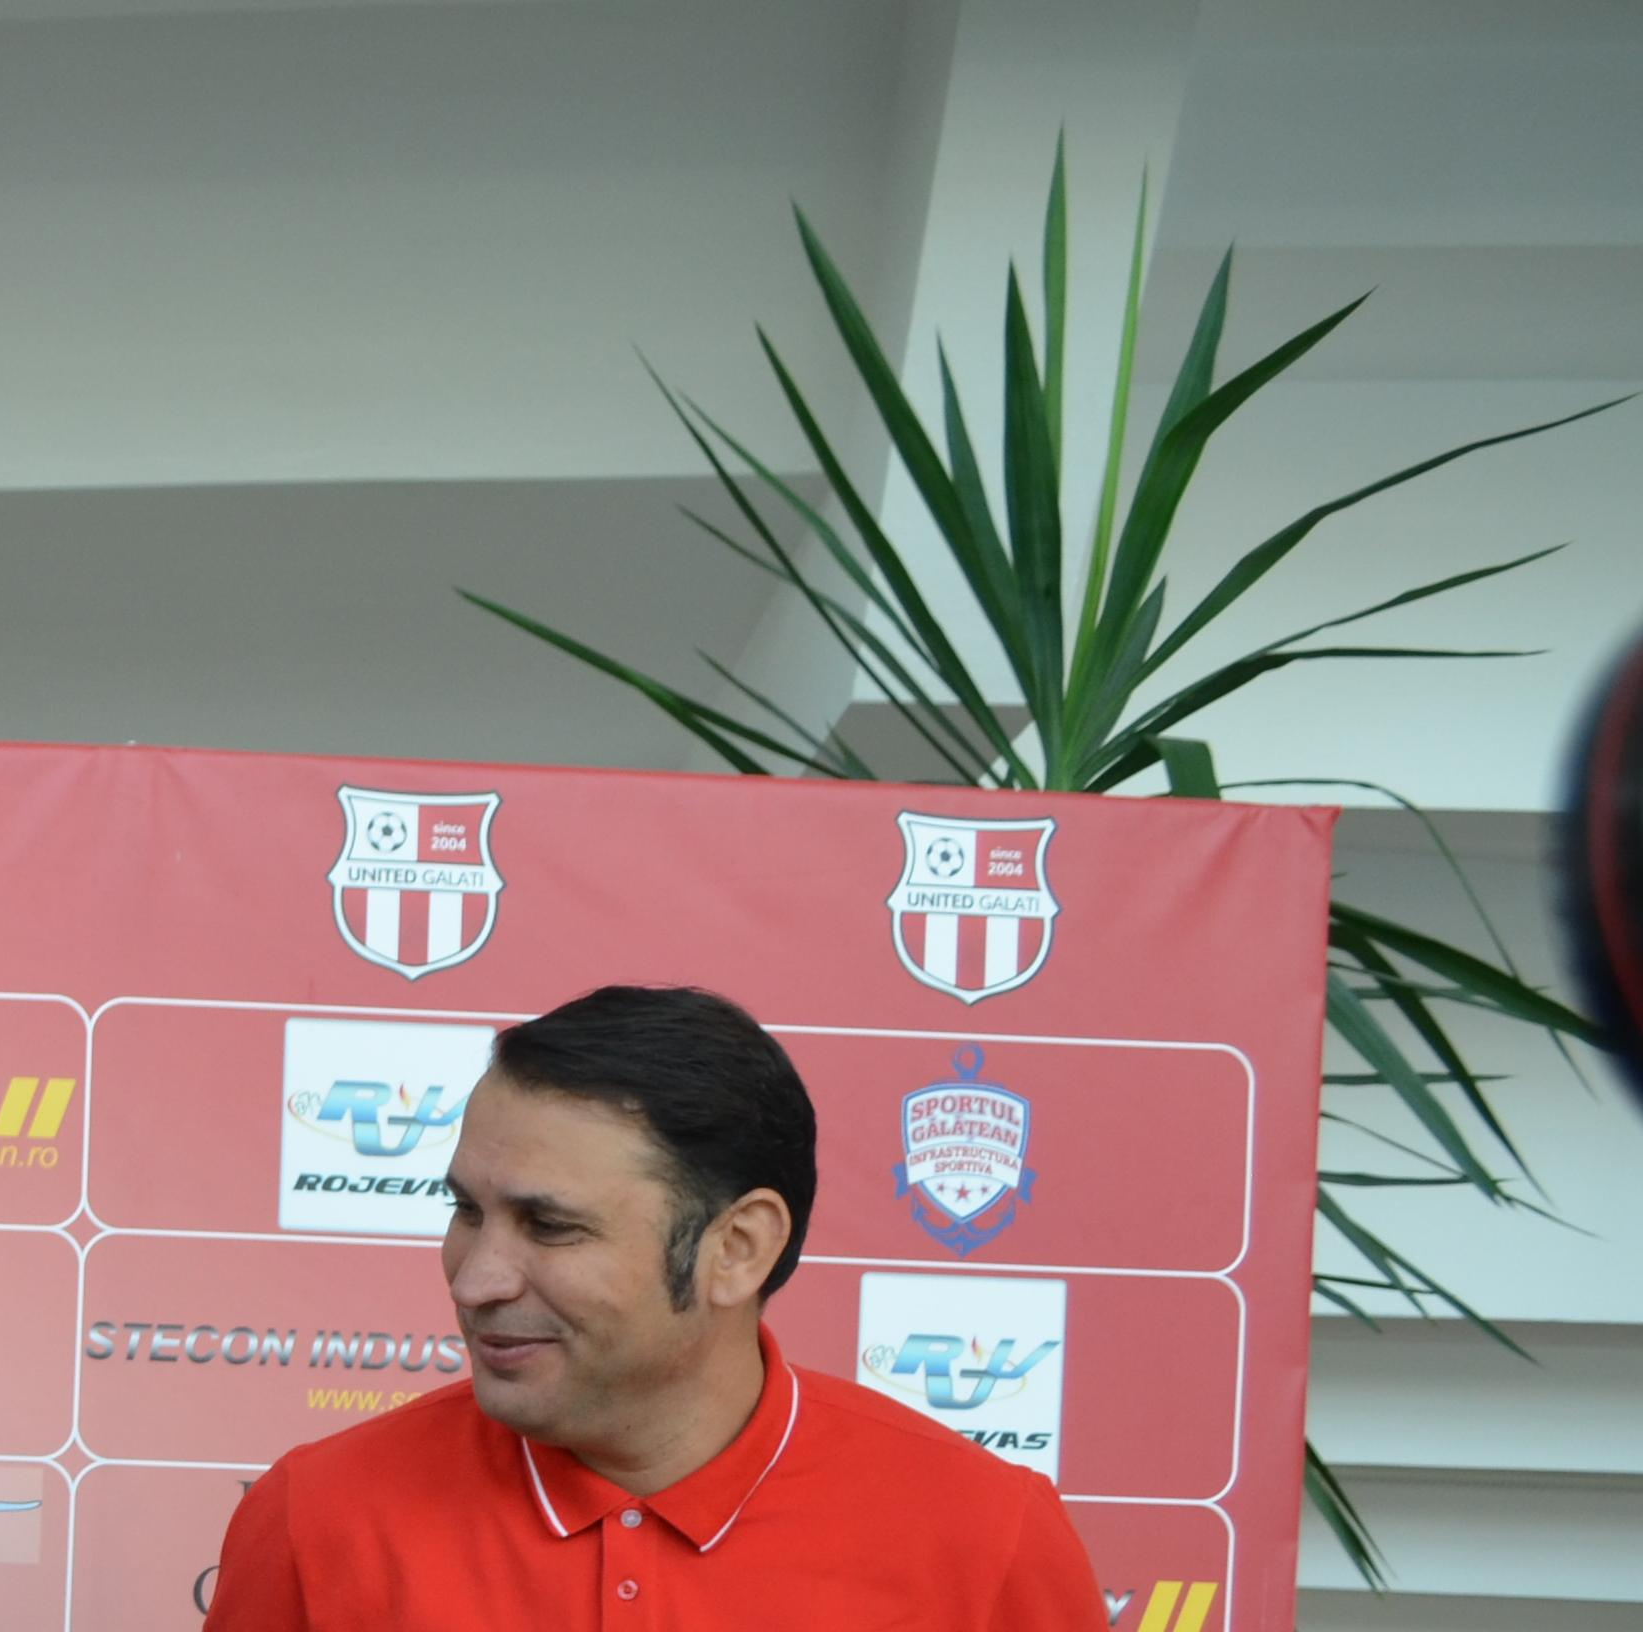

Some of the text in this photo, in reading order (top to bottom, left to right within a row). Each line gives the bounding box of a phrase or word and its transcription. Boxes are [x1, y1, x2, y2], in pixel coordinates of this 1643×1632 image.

[432, 820, 466, 834] since
[431, 836, 467, 852] 2004
[348, 866, 484, 887] UNITED GALATI
[988, 862, 1023, 876] 2004
[907, 892, 1040, 913] UNITED GALATI
[911, 1095, 1020, 1126] SPORTUL
[293, 1173, 451, 1197] ROJEVA
[86, 1320, 466, 1375] STECON INDUS
